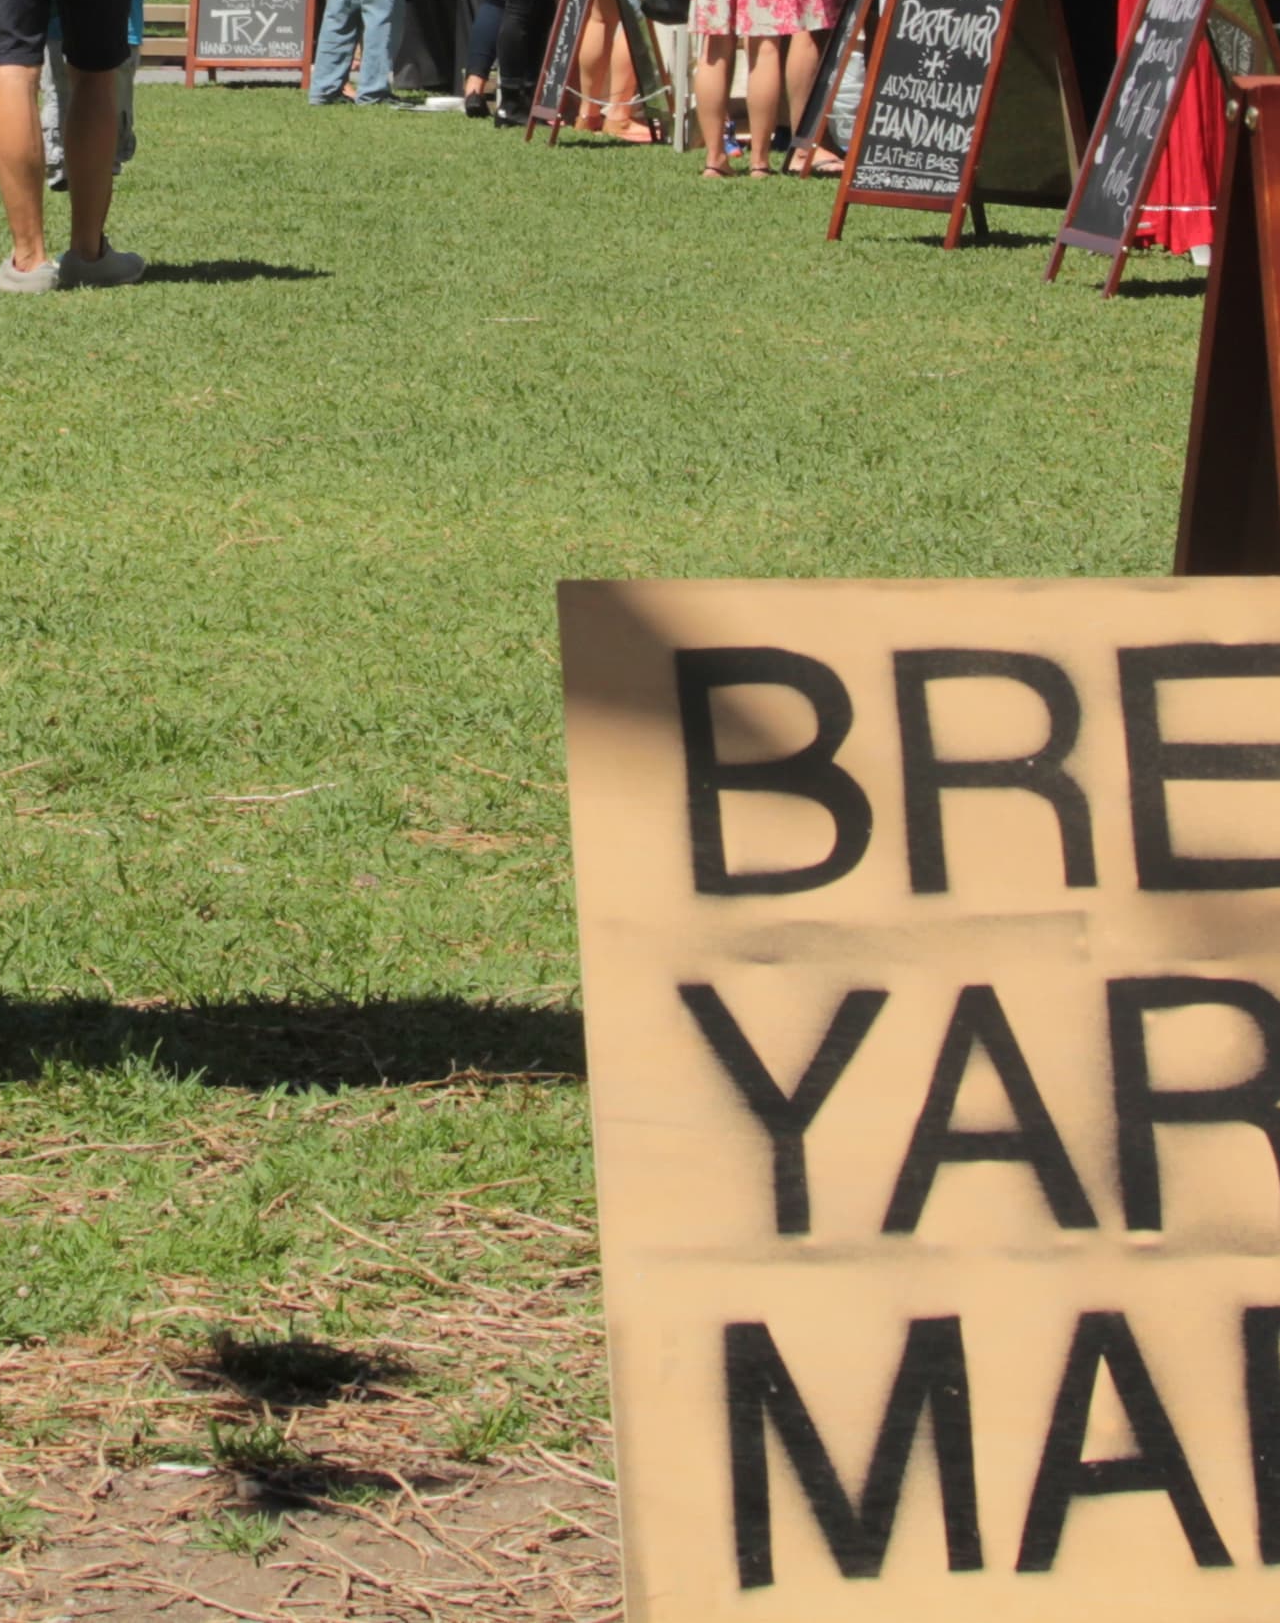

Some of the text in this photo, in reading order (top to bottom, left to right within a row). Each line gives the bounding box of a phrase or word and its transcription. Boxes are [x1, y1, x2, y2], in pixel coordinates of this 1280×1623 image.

[210, 9, 278, 46] TRY
[200, 41, 232, 56] HAND
[233, 43, 260, 56] WASH
[880, 74, 983, 119] AUSTRALIAN
[868, 101, 976, 154] HANDMADE
[863, 144, 959, 174] LEATHER BAGS
